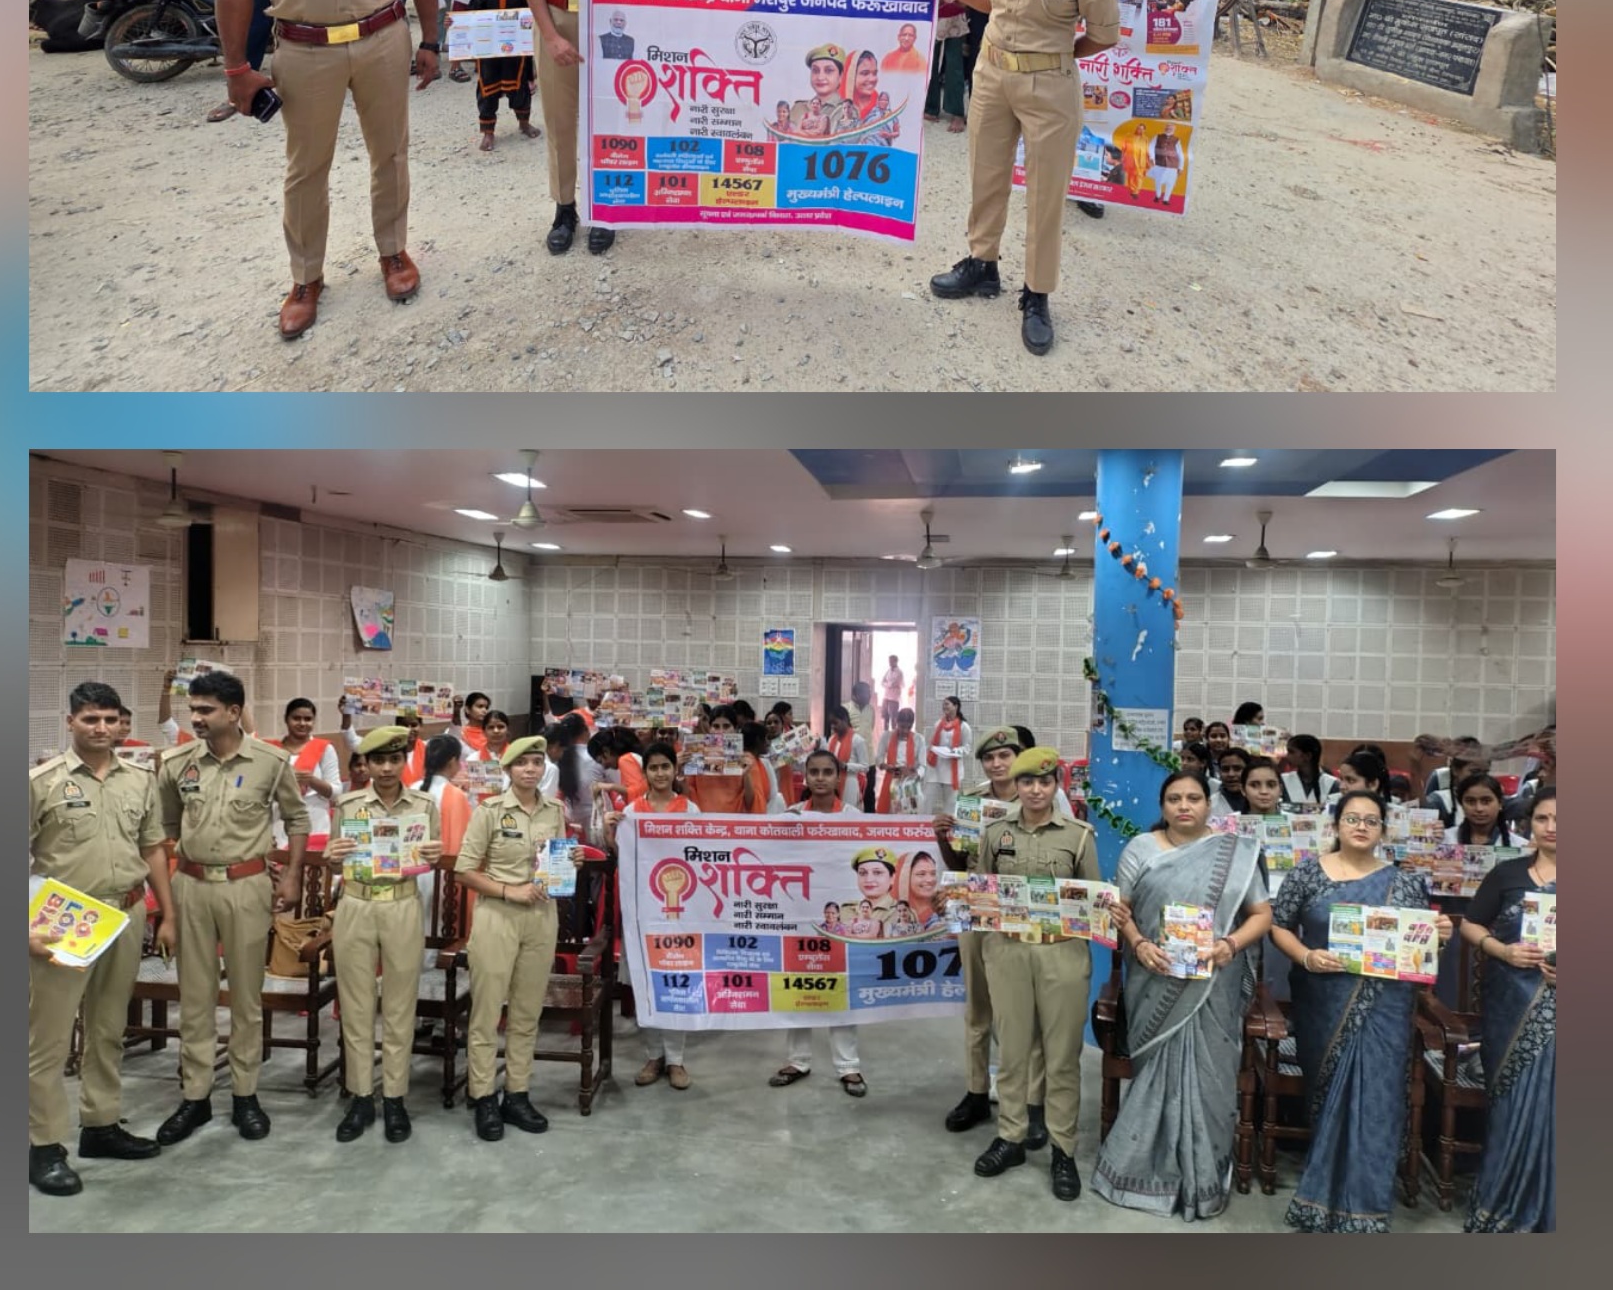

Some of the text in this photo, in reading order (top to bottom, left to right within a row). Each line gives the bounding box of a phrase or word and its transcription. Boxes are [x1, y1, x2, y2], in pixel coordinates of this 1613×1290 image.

[1153, 18, 1171, 27] 181
[646, 45, 688, 63] मिशन
[1079, 53, 1159, 87] नारी शक्ति
[658, 48, 764, 123] शक्ति
[689, 104, 735, 117] नारी सुरक्षा
[689, 116, 742, 127] नारी सम्मान
[689, 127, 709, 137] नारी
[600, 137, 638, 151] 1090
[669, 140, 699, 152] 102
[735, 144, 764, 156] 108
[804, 150, 890, 184] 1076
[603, 174, 634, 187] 112
[659, 175, 687, 188] 101
[712, 177, 763, 191] 14567
[786, 186, 905, 210] मुख्यमंत्री हेल्पलाइन
[644, 821, 673, 834] मिशन
[675, 821, 703, 835] शक्ति
[734, 825, 757, 836] थाना
[760, 824, 804, 837] कोतवाली
[866, 826, 900, 837] जनपद
[684, 846, 731, 862] मिशन
[698, 847, 814, 919] शक्ति
[733, 900, 778, 912] नारी सुरक्षा
[733, 910, 784, 920] नारी सम्मान
[733, 921, 798, 931] नारी स्वावलंबन
[654, 935, 695, 949] 1090
[728, 936, 758, 949] 102
[797, 939, 831, 952] 108
[876, 946, 963, 980] 107
[661, 974, 690, 988] 112
[721, 974, 753, 988] 101
[783, 977, 838, 991] 14567
[858, 979, 936, 1005] मुख्यमंत्री
